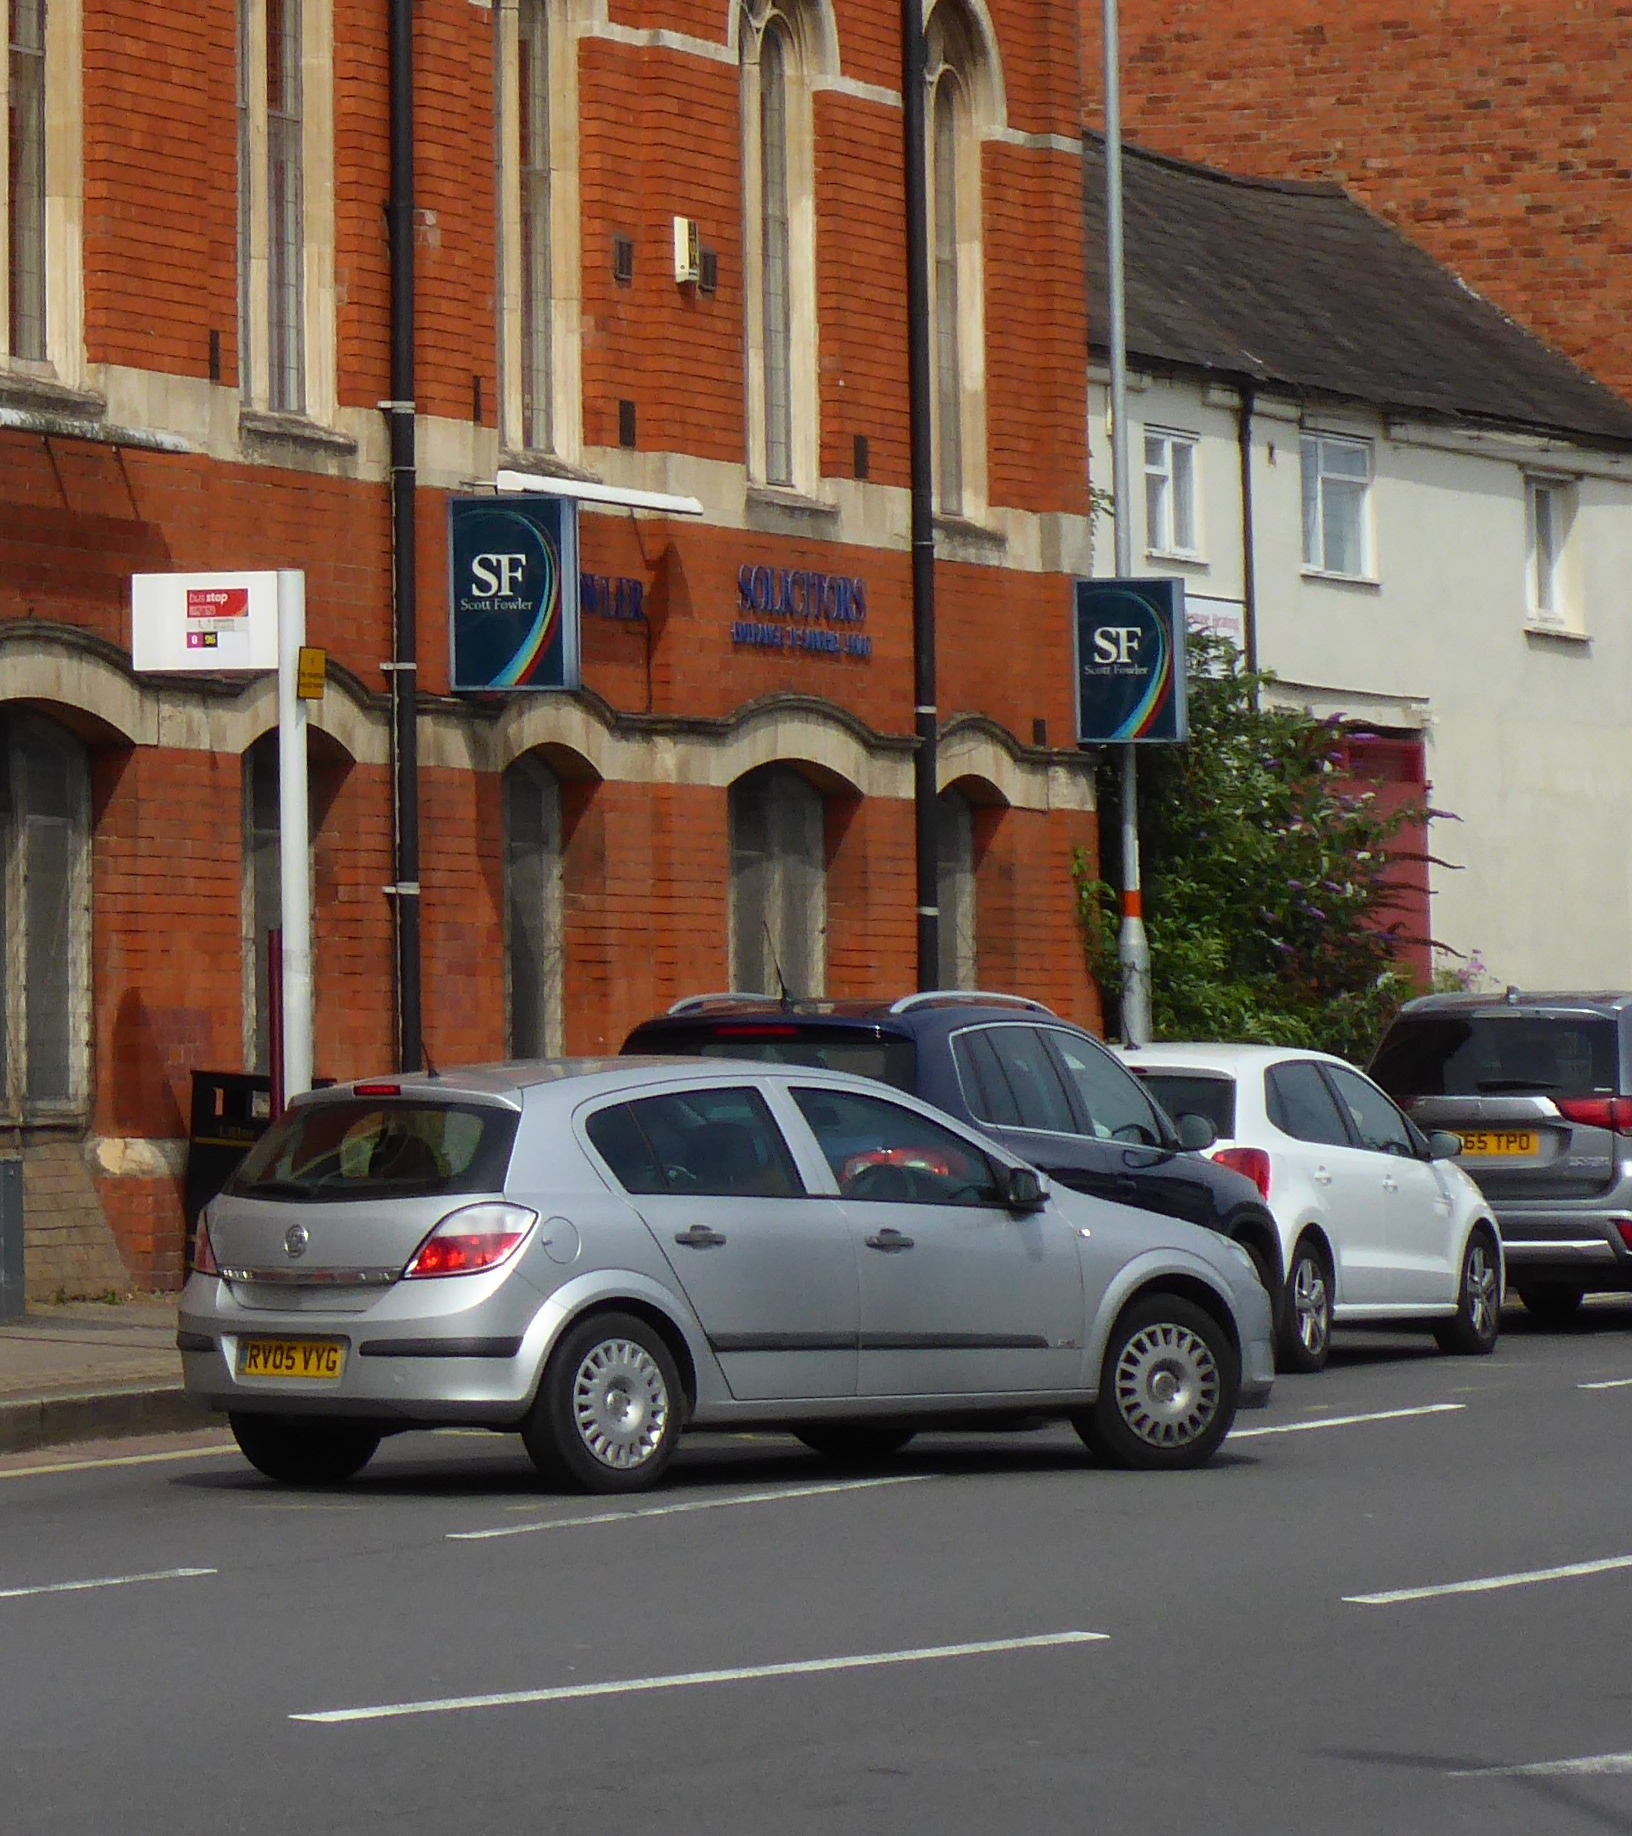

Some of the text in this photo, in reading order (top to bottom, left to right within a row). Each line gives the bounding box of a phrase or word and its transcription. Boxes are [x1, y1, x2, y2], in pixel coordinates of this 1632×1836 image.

[471, 554, 526, 597] SF
[206, 592, 229, 605] stop
[460, 598, 533, 611] Scott Fowler
[737, 564, 867, 622] SOLICITORS
[1093, 627, 1143, 664] SF
[1495, 1133, 1530, 1151] TPO
[302, 1346, 338, 1372] VYG
